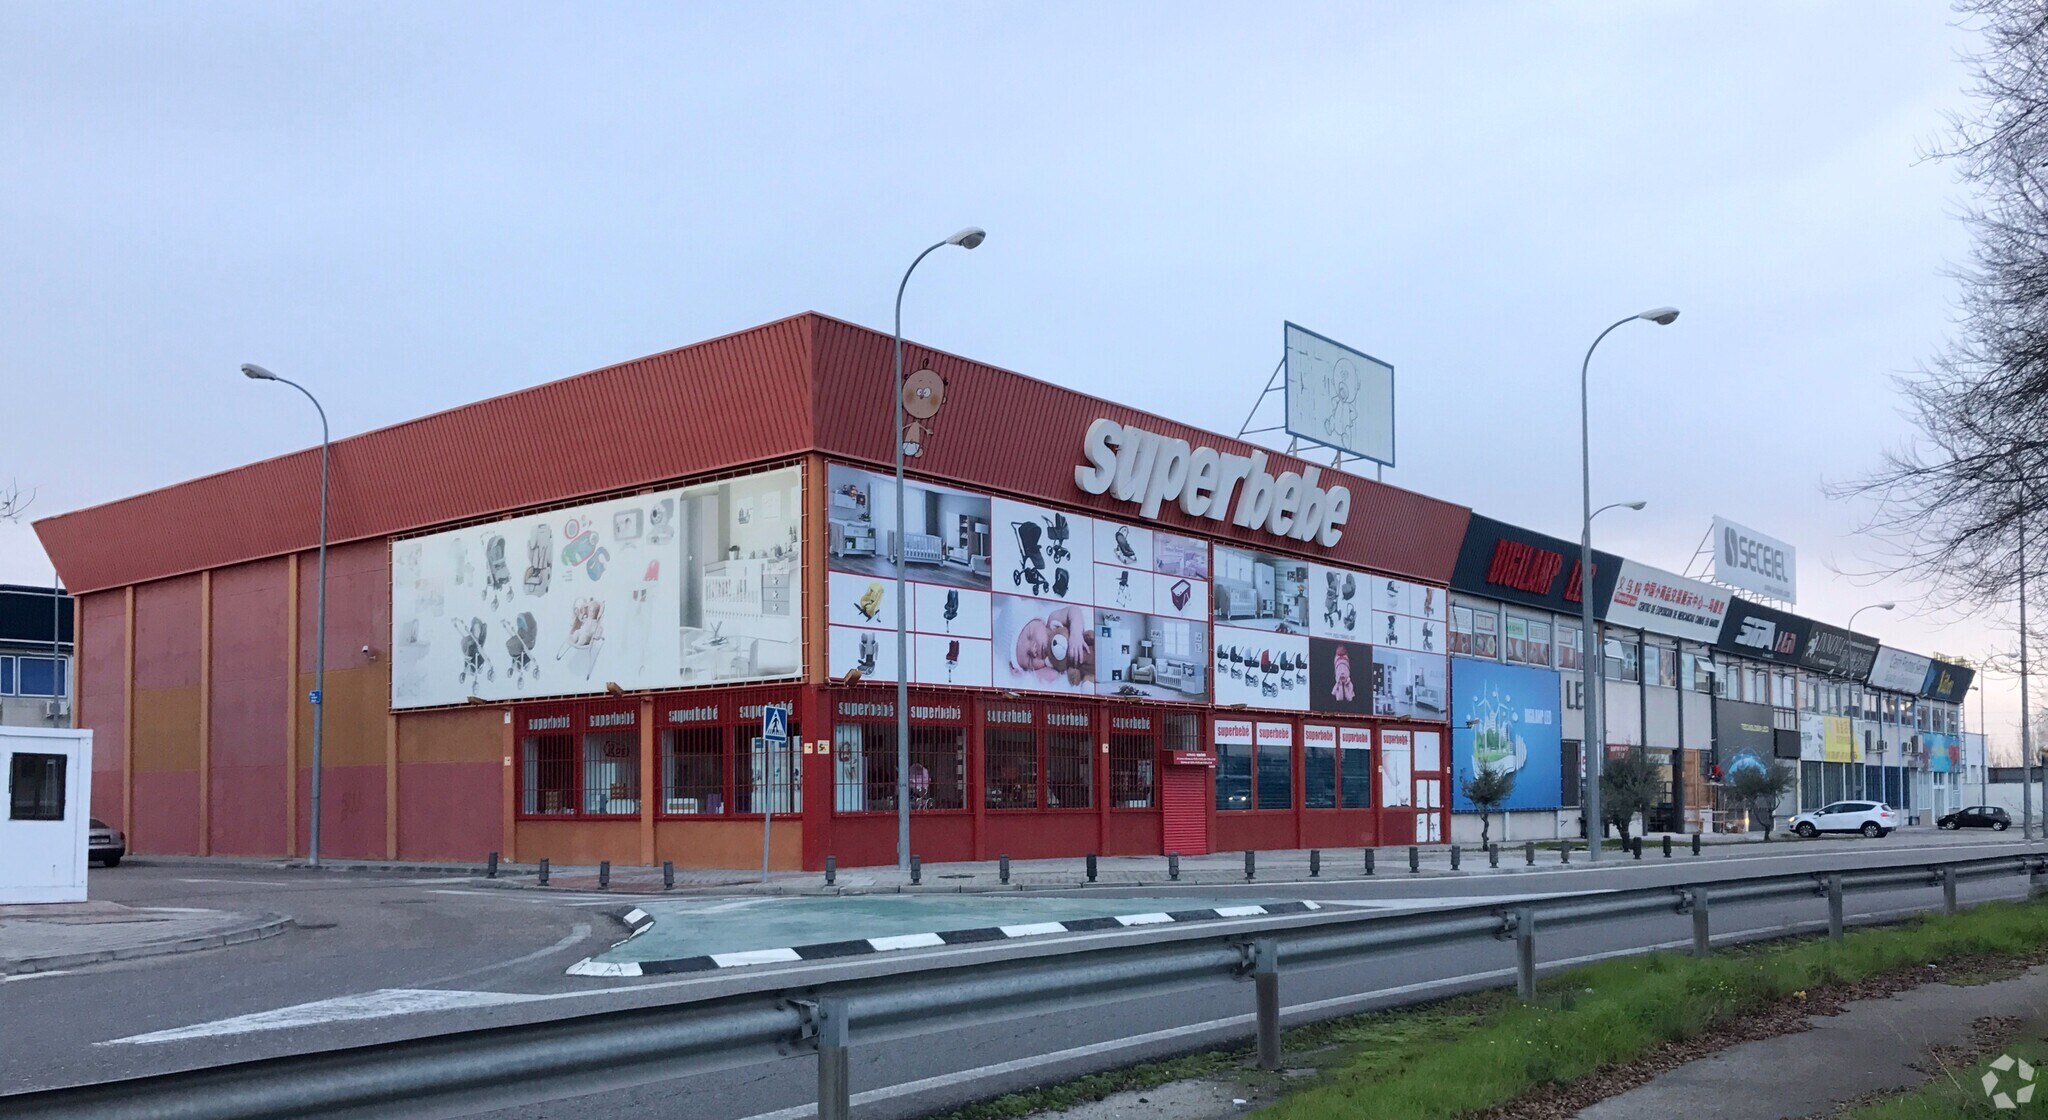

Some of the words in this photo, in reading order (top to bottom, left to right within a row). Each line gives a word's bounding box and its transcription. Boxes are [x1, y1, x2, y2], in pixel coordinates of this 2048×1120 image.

[1075, 418, 1350, 548] superbebe
[1487, 539, 1564, 595] DIGILAMP
[1217, 725, 1250, 738] superbebé
[1259, 727, 1289, 740] superbebé
[1305, 730, 1333, 742] superbebé
